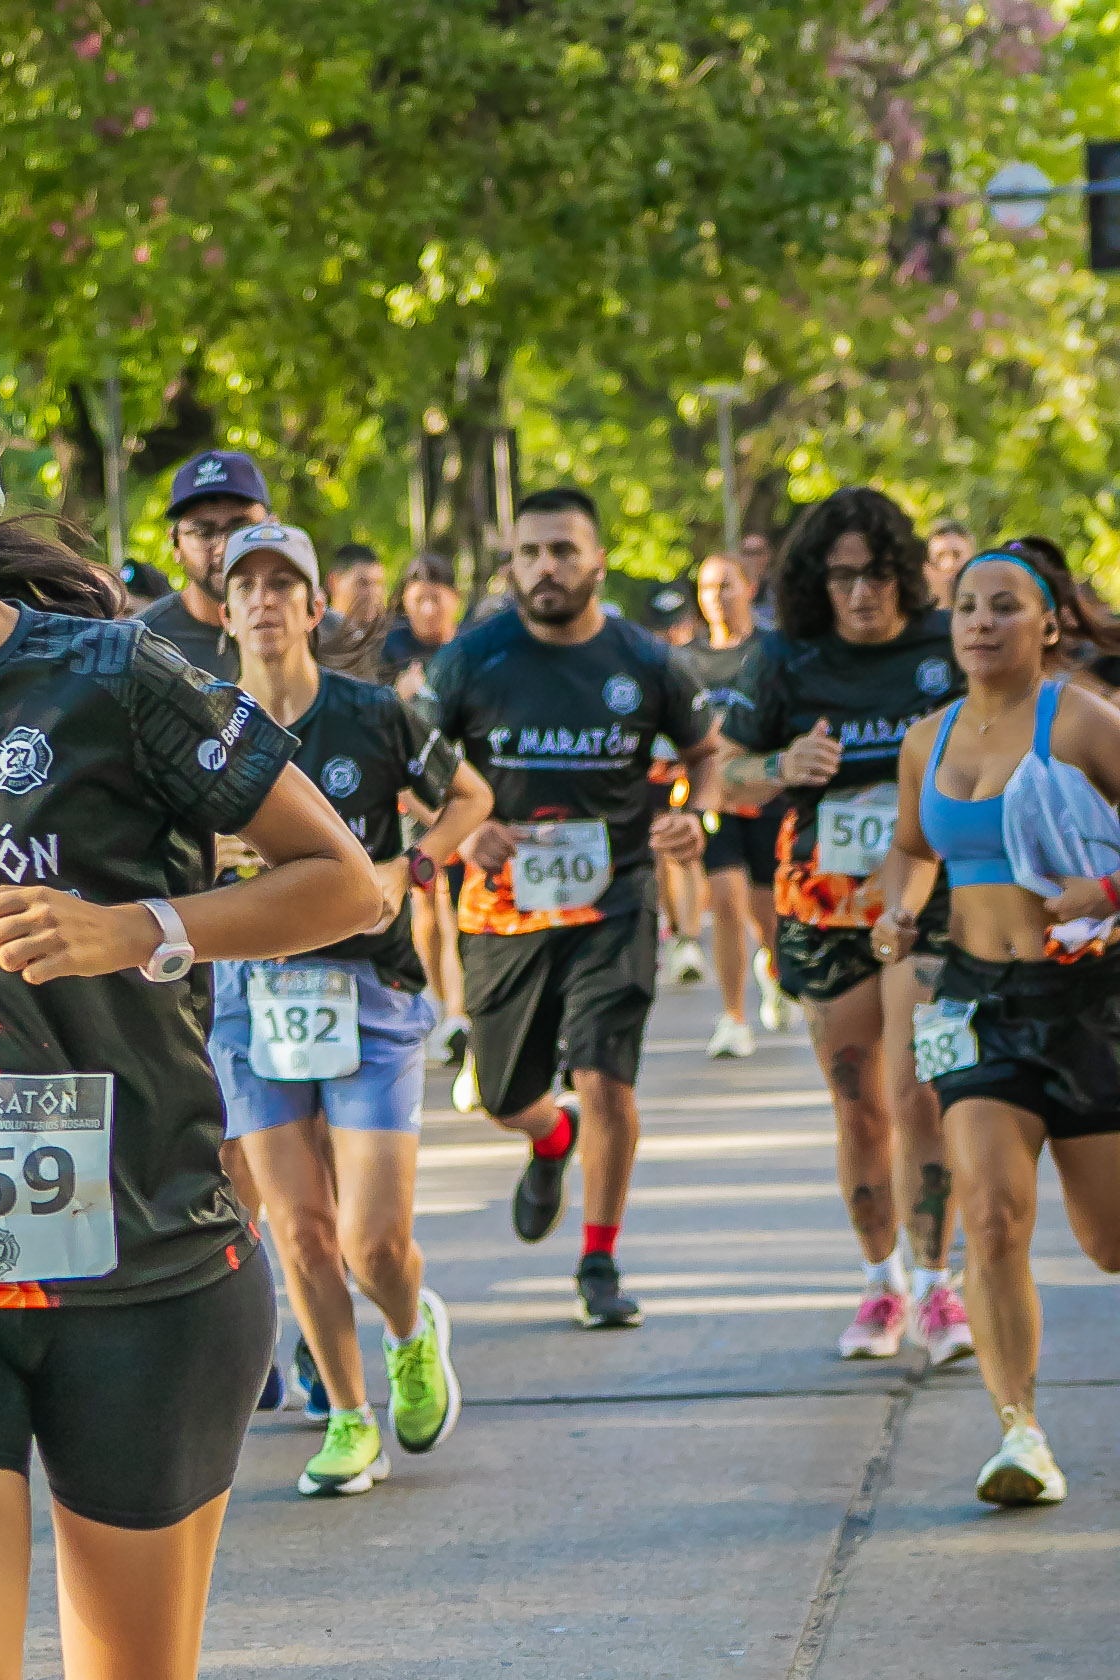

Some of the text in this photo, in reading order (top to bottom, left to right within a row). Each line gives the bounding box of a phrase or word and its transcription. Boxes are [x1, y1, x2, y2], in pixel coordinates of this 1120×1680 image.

[220, 706, 249, 748] Banco
[6, 747, 31, 770] 27
[523, 854, 594, 885] 640
[265, 1006, 340, 1043] 182
[0, 1118, 59, 1132] VOLUNTARIOS
